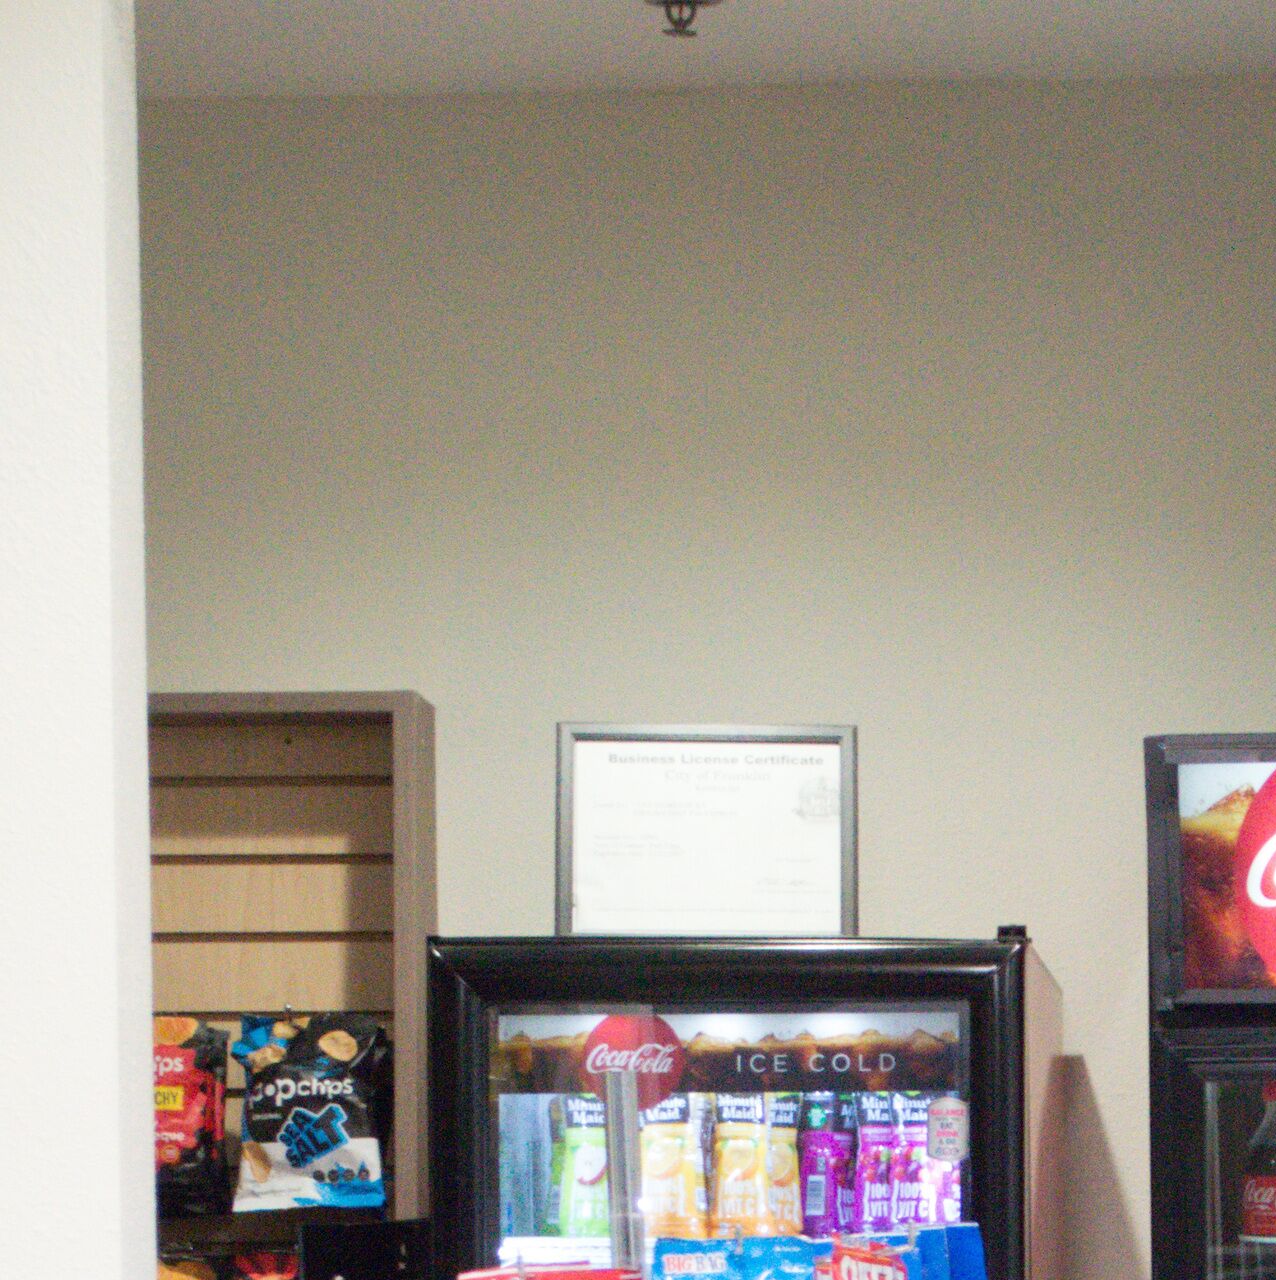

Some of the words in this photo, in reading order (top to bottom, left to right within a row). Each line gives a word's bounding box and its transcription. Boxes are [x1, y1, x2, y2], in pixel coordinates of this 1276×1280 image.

[609, 754, 675, 765] Business
[680, 754, 739, 765] License
[744, 754, 824, 766] Certificate
[665, 770, 691, 782] City
[586, 1042, 675, 1075] Coca-Cola
[737, 1054, 788, 1073] ICE
[808, 1053, 897, 1073] COLD
[279, 1110, 313, 1148] SEA
[285, 1105, 343, 1168] SALT
